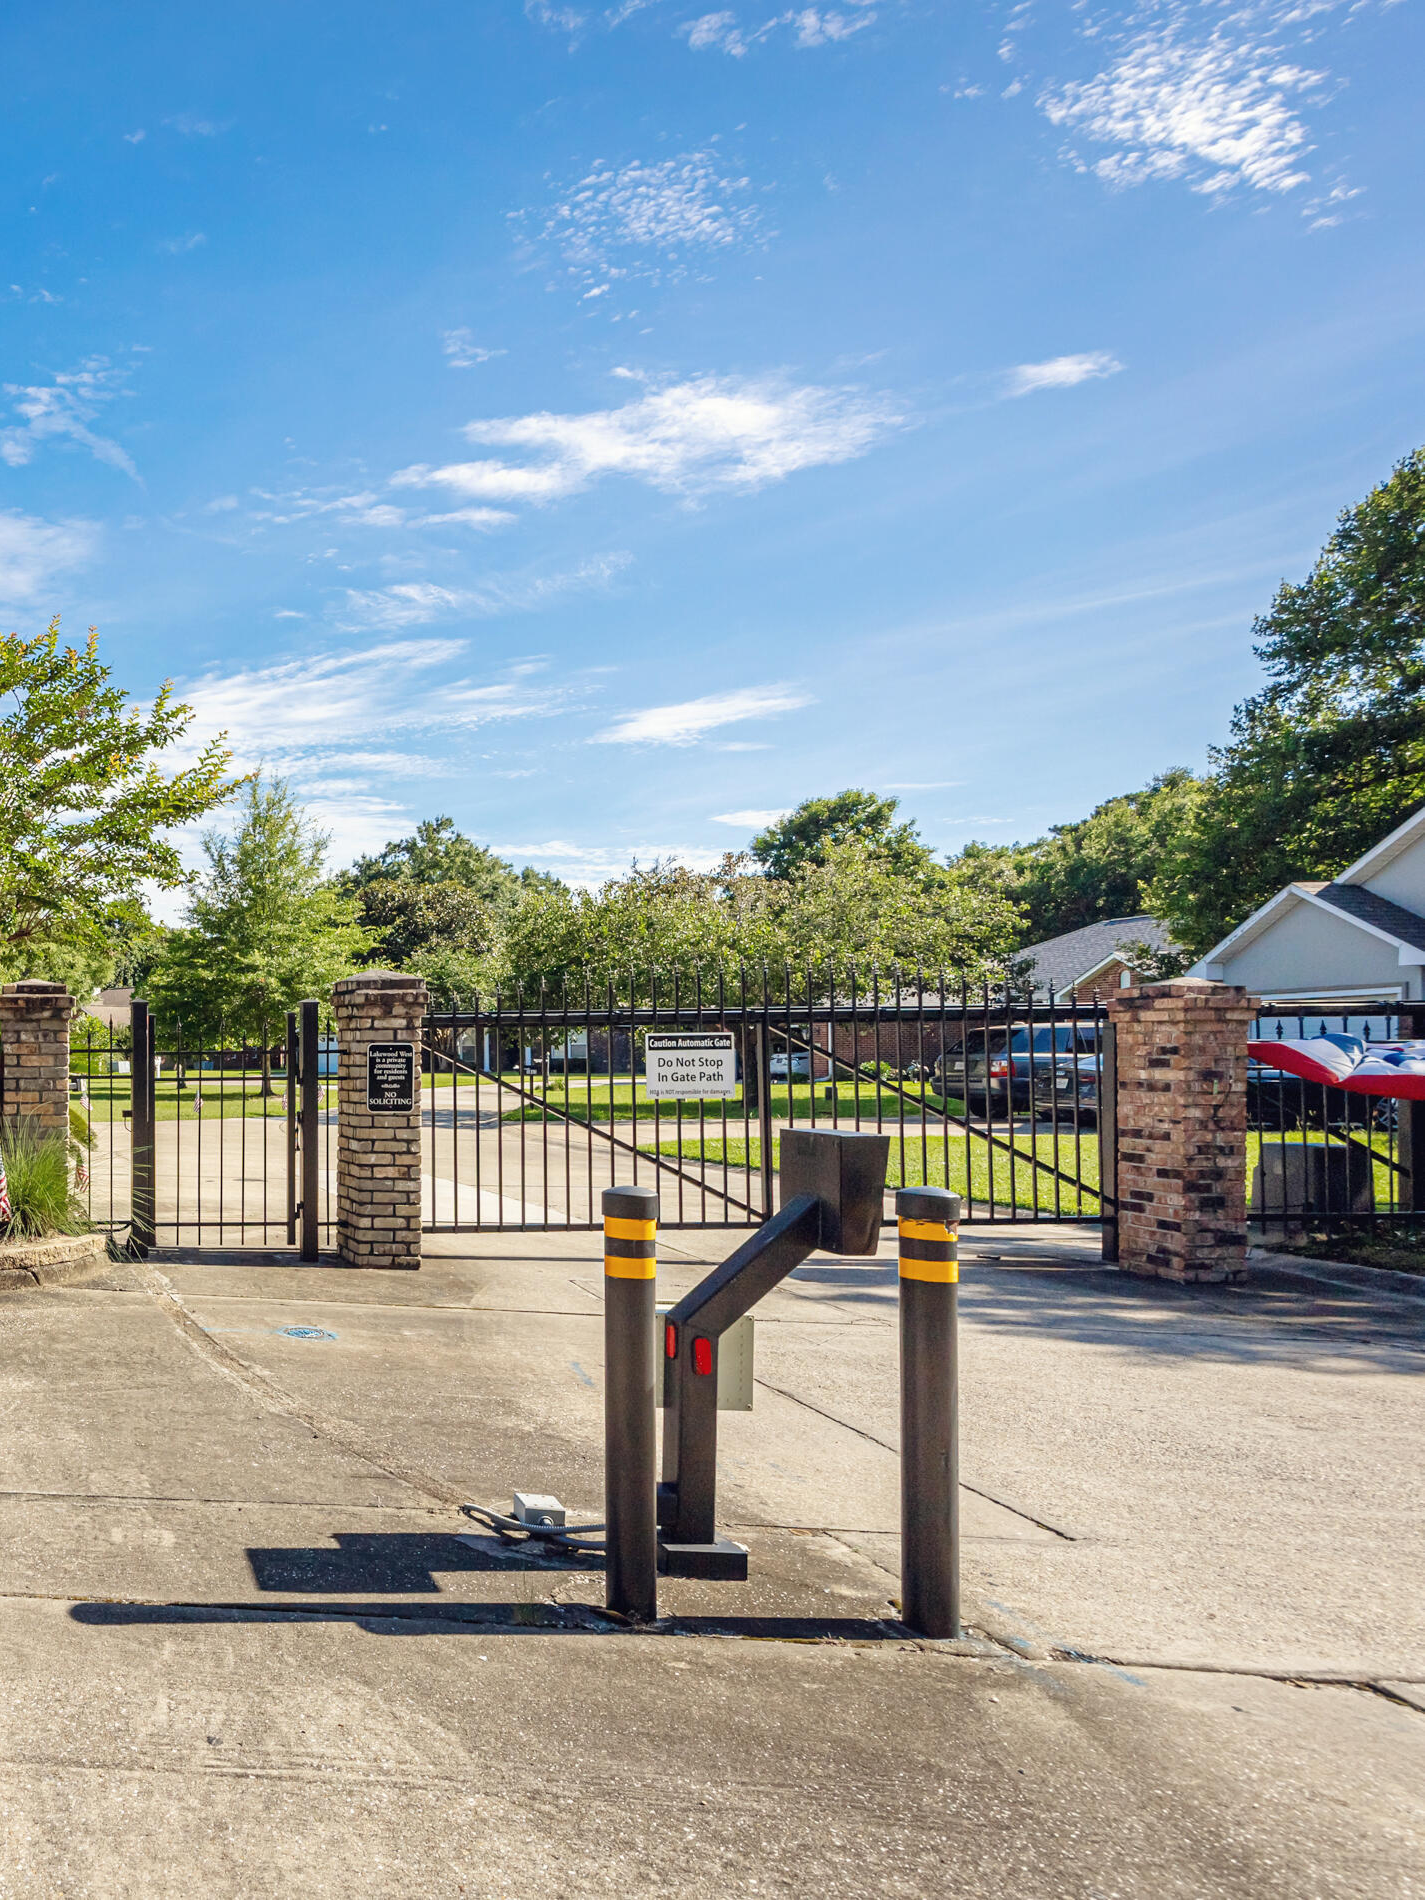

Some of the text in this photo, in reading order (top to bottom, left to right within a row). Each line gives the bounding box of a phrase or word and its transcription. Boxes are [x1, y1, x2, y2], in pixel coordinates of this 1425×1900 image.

[649, 1038, 731, 1048] Caution Automatic Gate
[657, 1057, 723, 1069] Do Not Stop
[657, 1071, 724, 1082] In Gate Path
